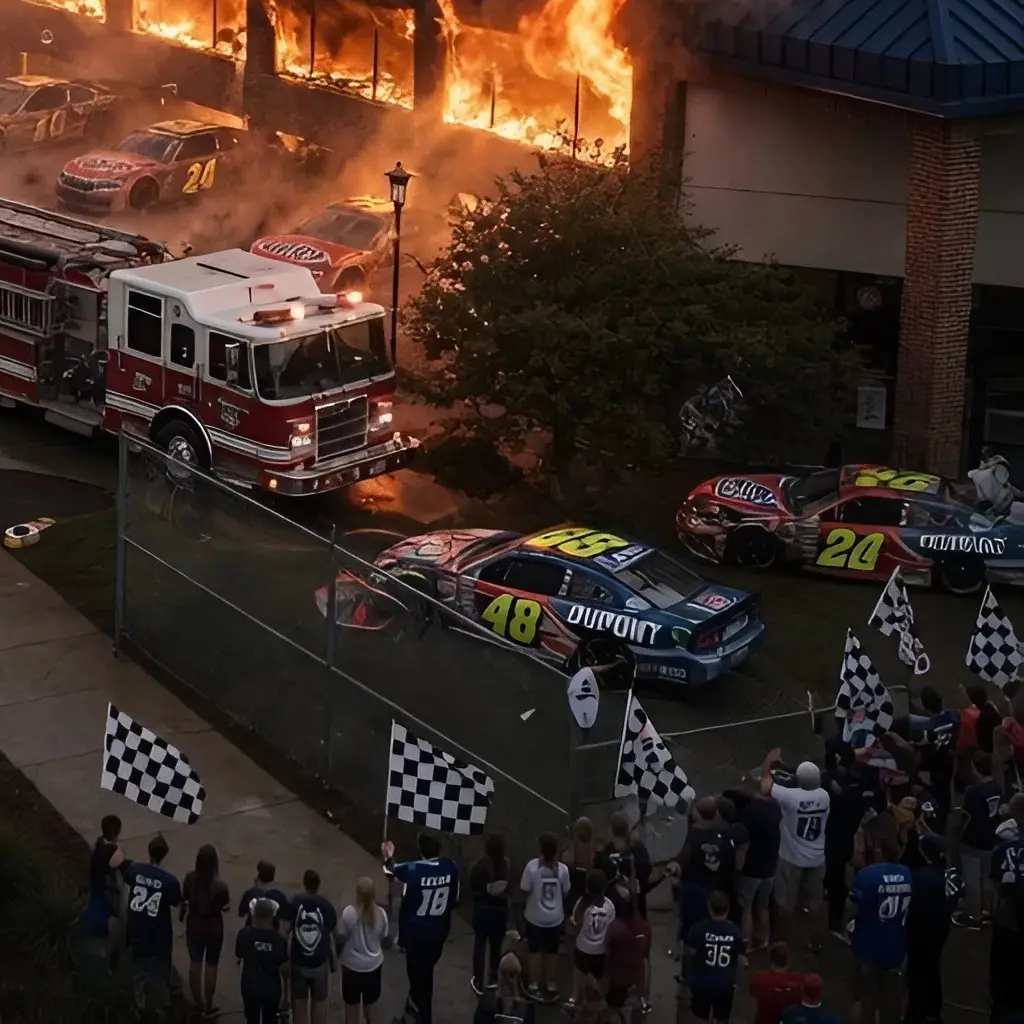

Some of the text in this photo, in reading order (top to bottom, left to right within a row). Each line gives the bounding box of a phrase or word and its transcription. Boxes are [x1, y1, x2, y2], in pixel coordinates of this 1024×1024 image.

[181, 158, 217, 194] 24
[815, 528, 886, 571] 24
[481, 593, 543, 646] 48
[130, 885, 163, 917] 24
